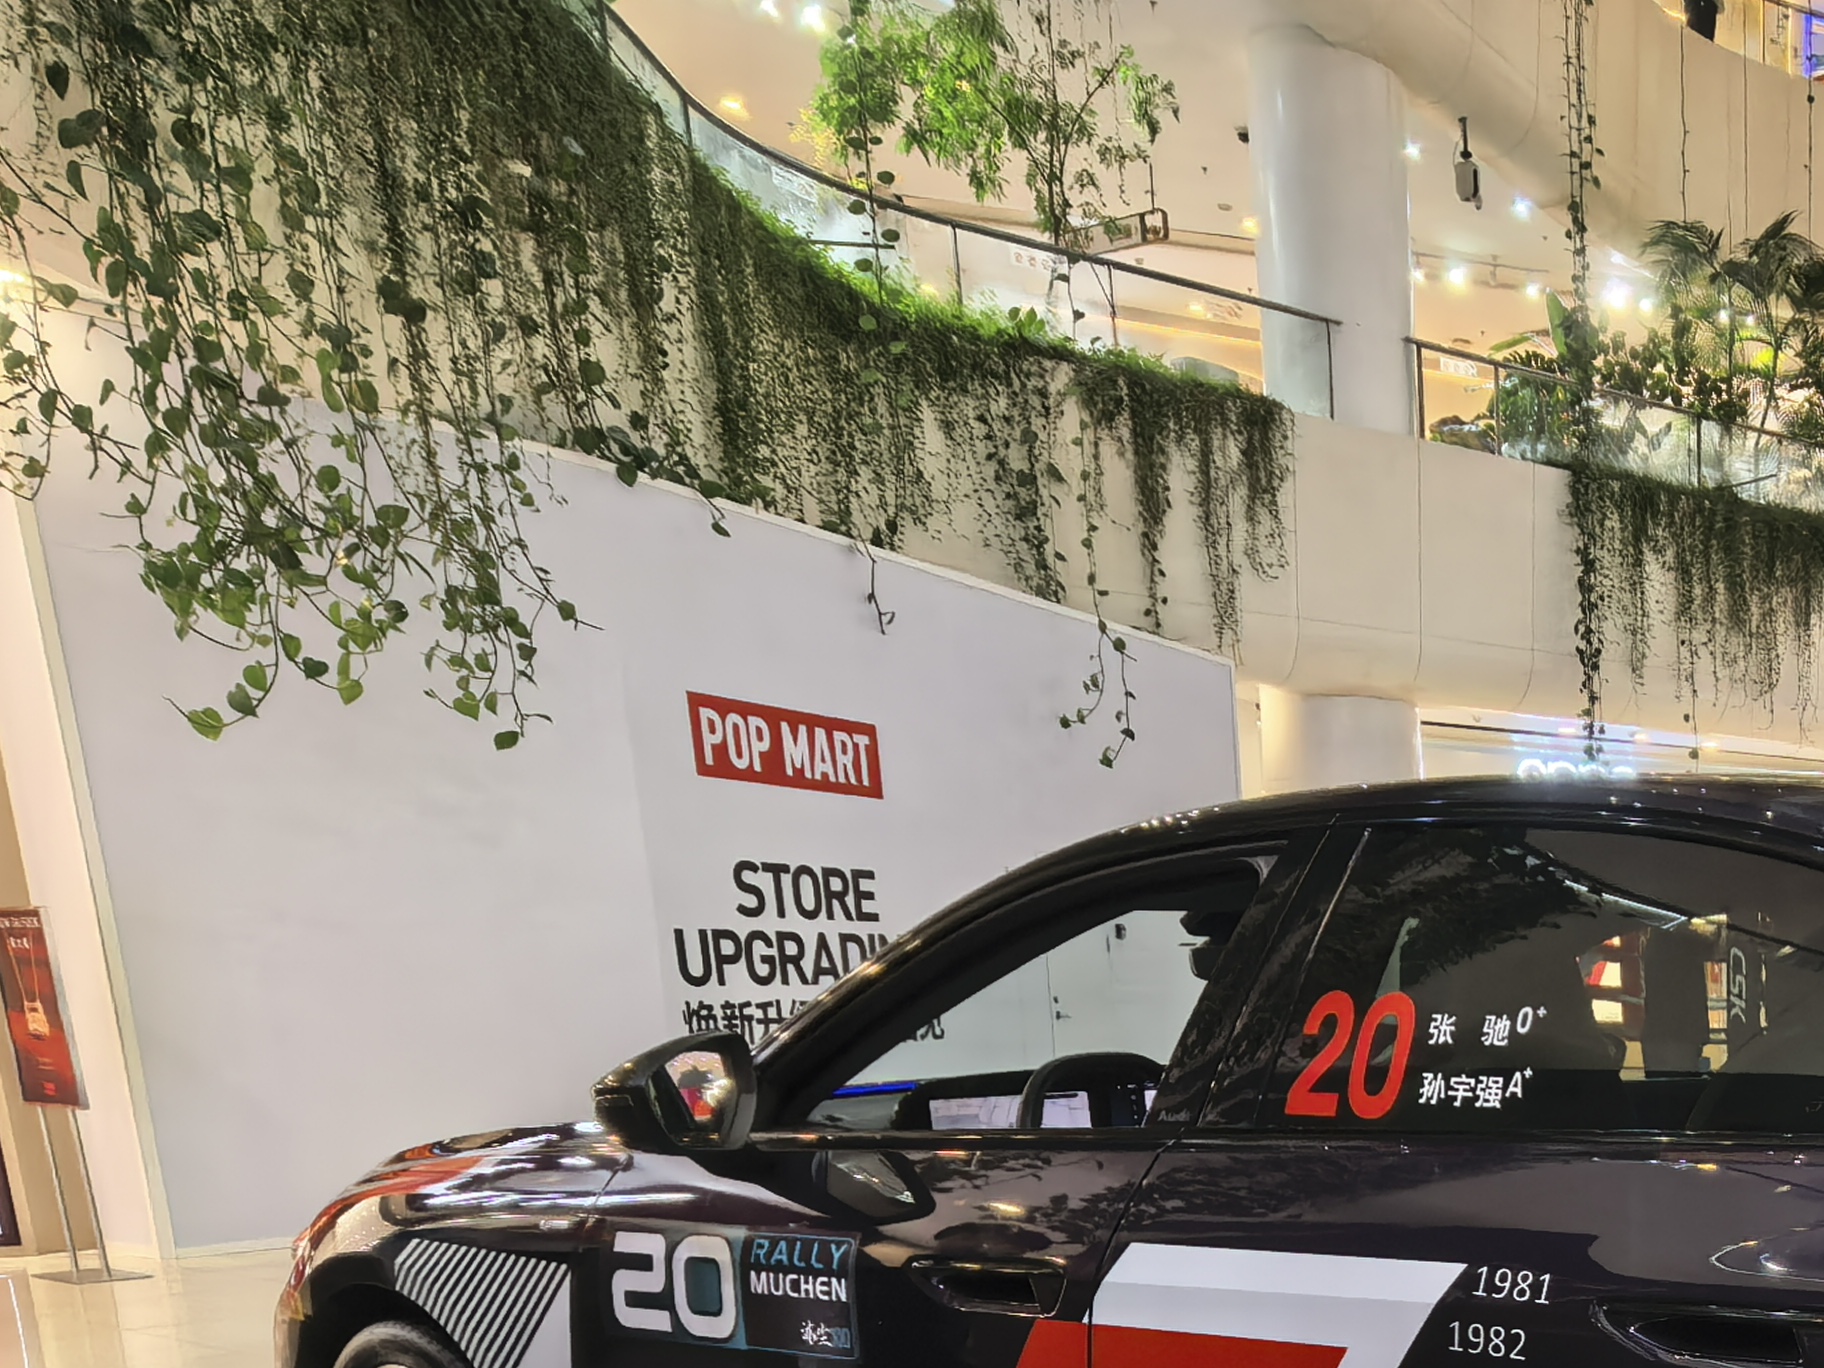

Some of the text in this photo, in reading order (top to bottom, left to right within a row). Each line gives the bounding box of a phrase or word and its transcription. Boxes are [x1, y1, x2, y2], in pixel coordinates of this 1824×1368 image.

[698, 706, 871, 788] POP MART
[733, 860, 880, 922] STORE
[673, 928, 900, 987] UPGRAD
[682, 1000, 807, 1046] 焕新升
[1284, 990, 1416, 1119] 20
[750, 1239, 849, 1270] RALLY
[611, 1231, 738, 1339] 20
[749, 1272, 848, 1302] MUCHEN
[1471, 1265, 1552, 1305] 1981
[1447, 1320, 1527, 1361] 1982
